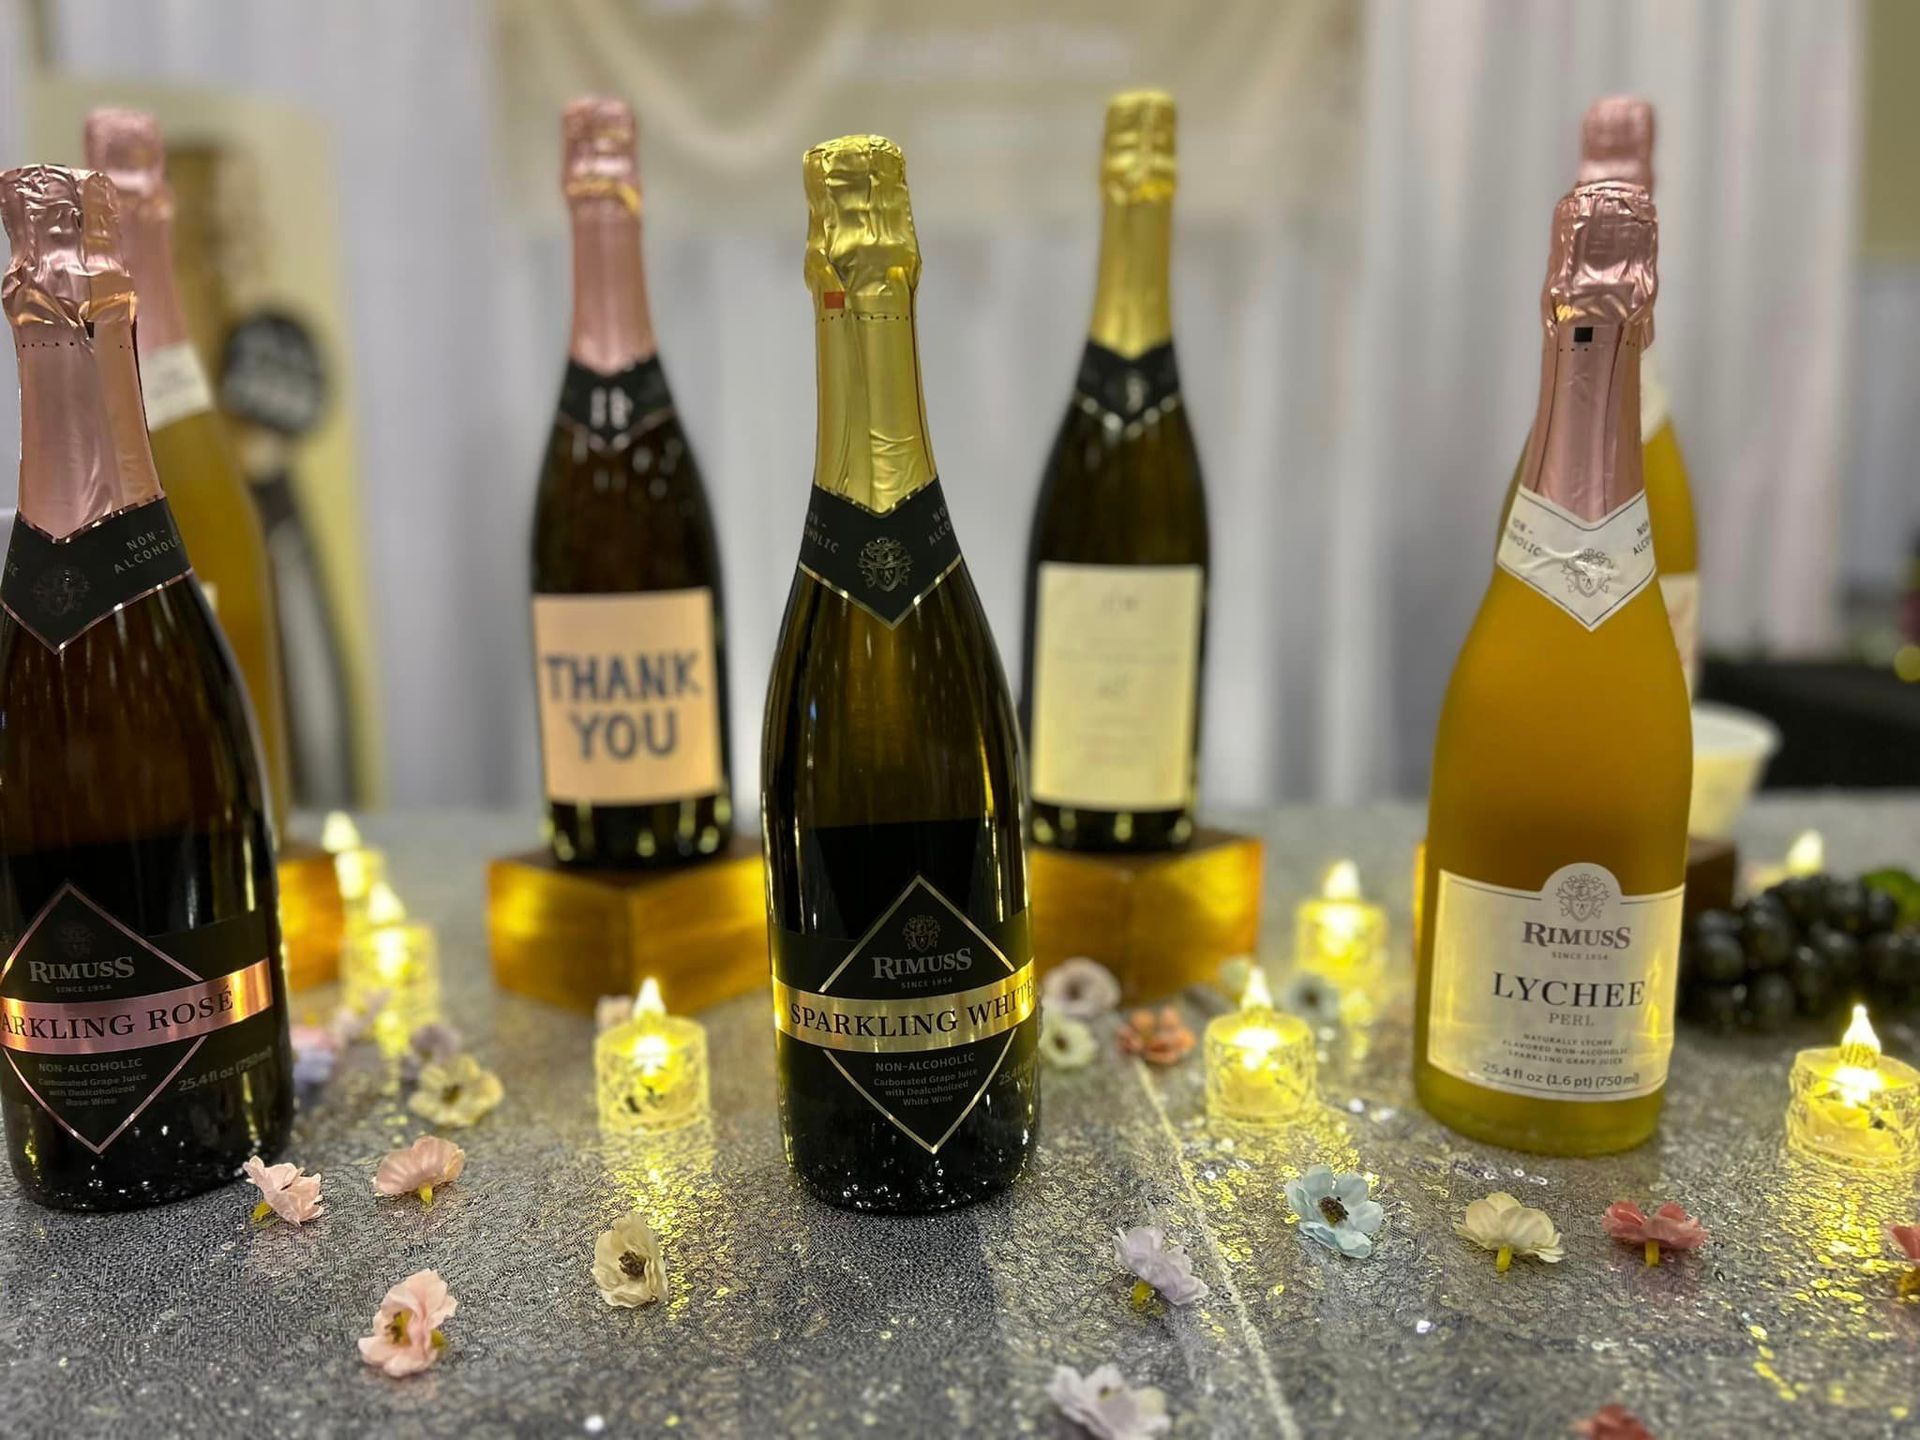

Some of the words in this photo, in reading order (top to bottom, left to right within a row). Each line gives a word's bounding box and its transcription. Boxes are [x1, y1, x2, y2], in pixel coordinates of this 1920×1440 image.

[543, 651, 702, 701] THANK
[569, 708, 679, 762] YOU
[1492, 971, 1645, 1008] LYCHEE
[148, 985, 233, 1031] ROSÉ
[790, 1002, 958, 1037] SPARKLING
[967, 977, 1035, 1026] WHITE
[1549, 1012, 1594, 1026] PERL
[38, 1058, 143, 1073] NON-ALCOHOLIC
[875, 1052, 975, 1072] NON-ALCOHOLIC
[90, 1077, 120, 1087] Grape
[122, 1073, 147, 1083] Juice
[178, 1074, 208, 1092] 25.4
[220, 1067, 234, 1079] oz
[873, 1075, 926, 1087] Carbonated
[929, 1073, 956, 1084] Grape
[958, 1068, 978, 1079] Juice
[1482, 1062, 1510, 1077] 25.4
[1513, 1068, 1523, 1079] fl
[1526, 1072, 1543, 1082] oz
[1546, 1073, 1571, 1086] (1.6
[1574, 1075, 1592, 1088] pt)
[885, 1088, 904, 1097] with
[907, 1081, 968, 1096] Dealcoholized
[902, 1097, 929, 1107] White
[932, 1094, 953, 1104] Wine
